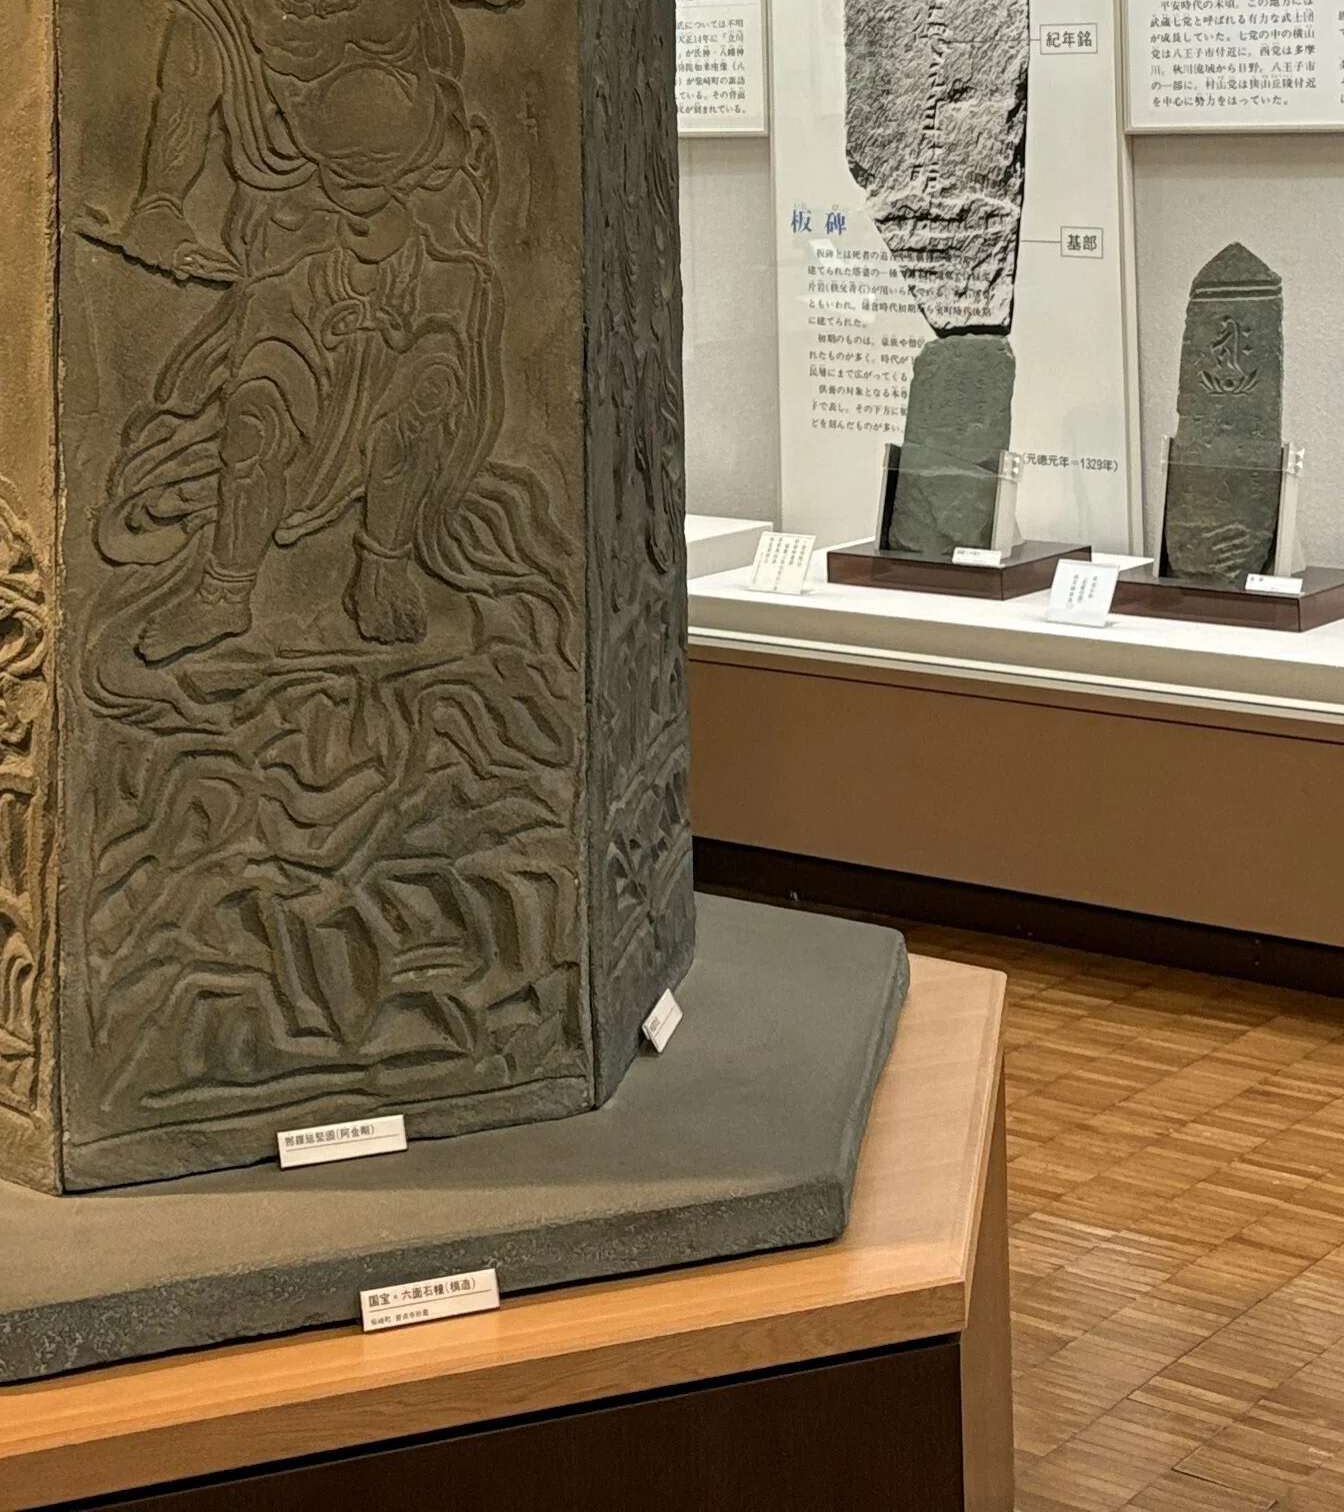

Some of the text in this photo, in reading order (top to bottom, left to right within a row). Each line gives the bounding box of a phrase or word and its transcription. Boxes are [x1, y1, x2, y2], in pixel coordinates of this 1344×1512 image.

[1045, 29, 1093, 48] 紀年銘
[1066, 234, 1097, 252] 基部
